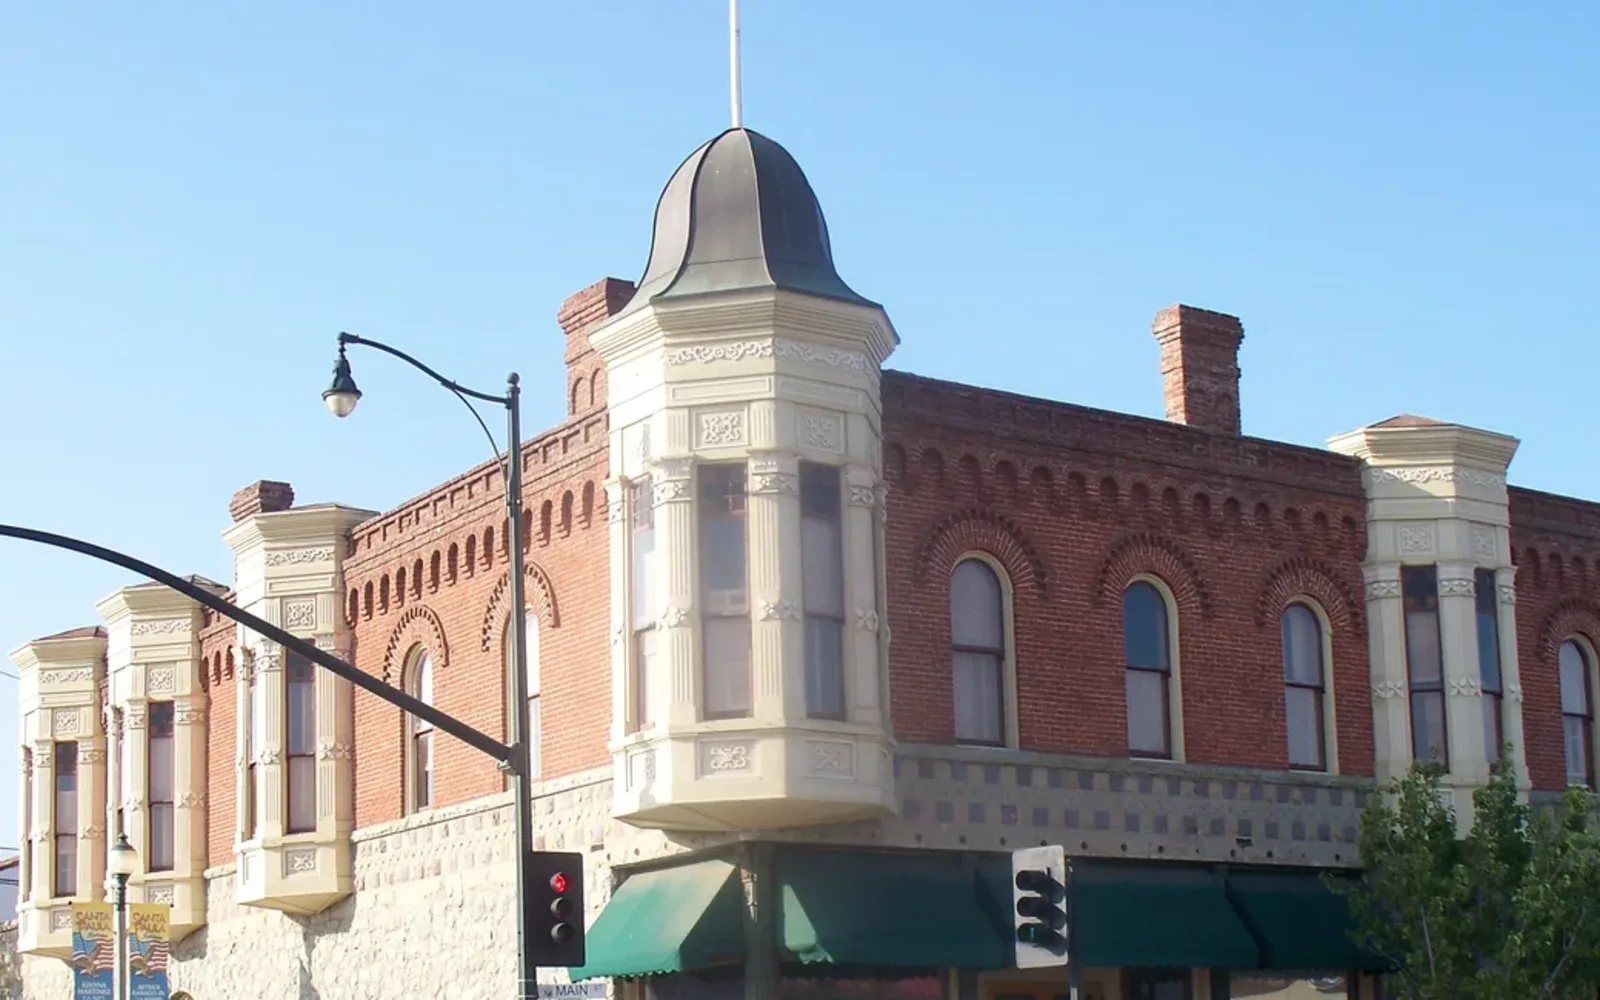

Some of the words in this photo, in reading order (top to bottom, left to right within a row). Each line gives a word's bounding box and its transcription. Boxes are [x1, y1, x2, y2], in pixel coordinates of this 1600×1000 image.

[76, 912, 110, 922] SANTA
[133, 912, 166, 923] SANTA
[77, 920, 111, 931] PAULA
[134, 921, 166, 932] PAULA
[556, 985, 588, 996] MAIN
